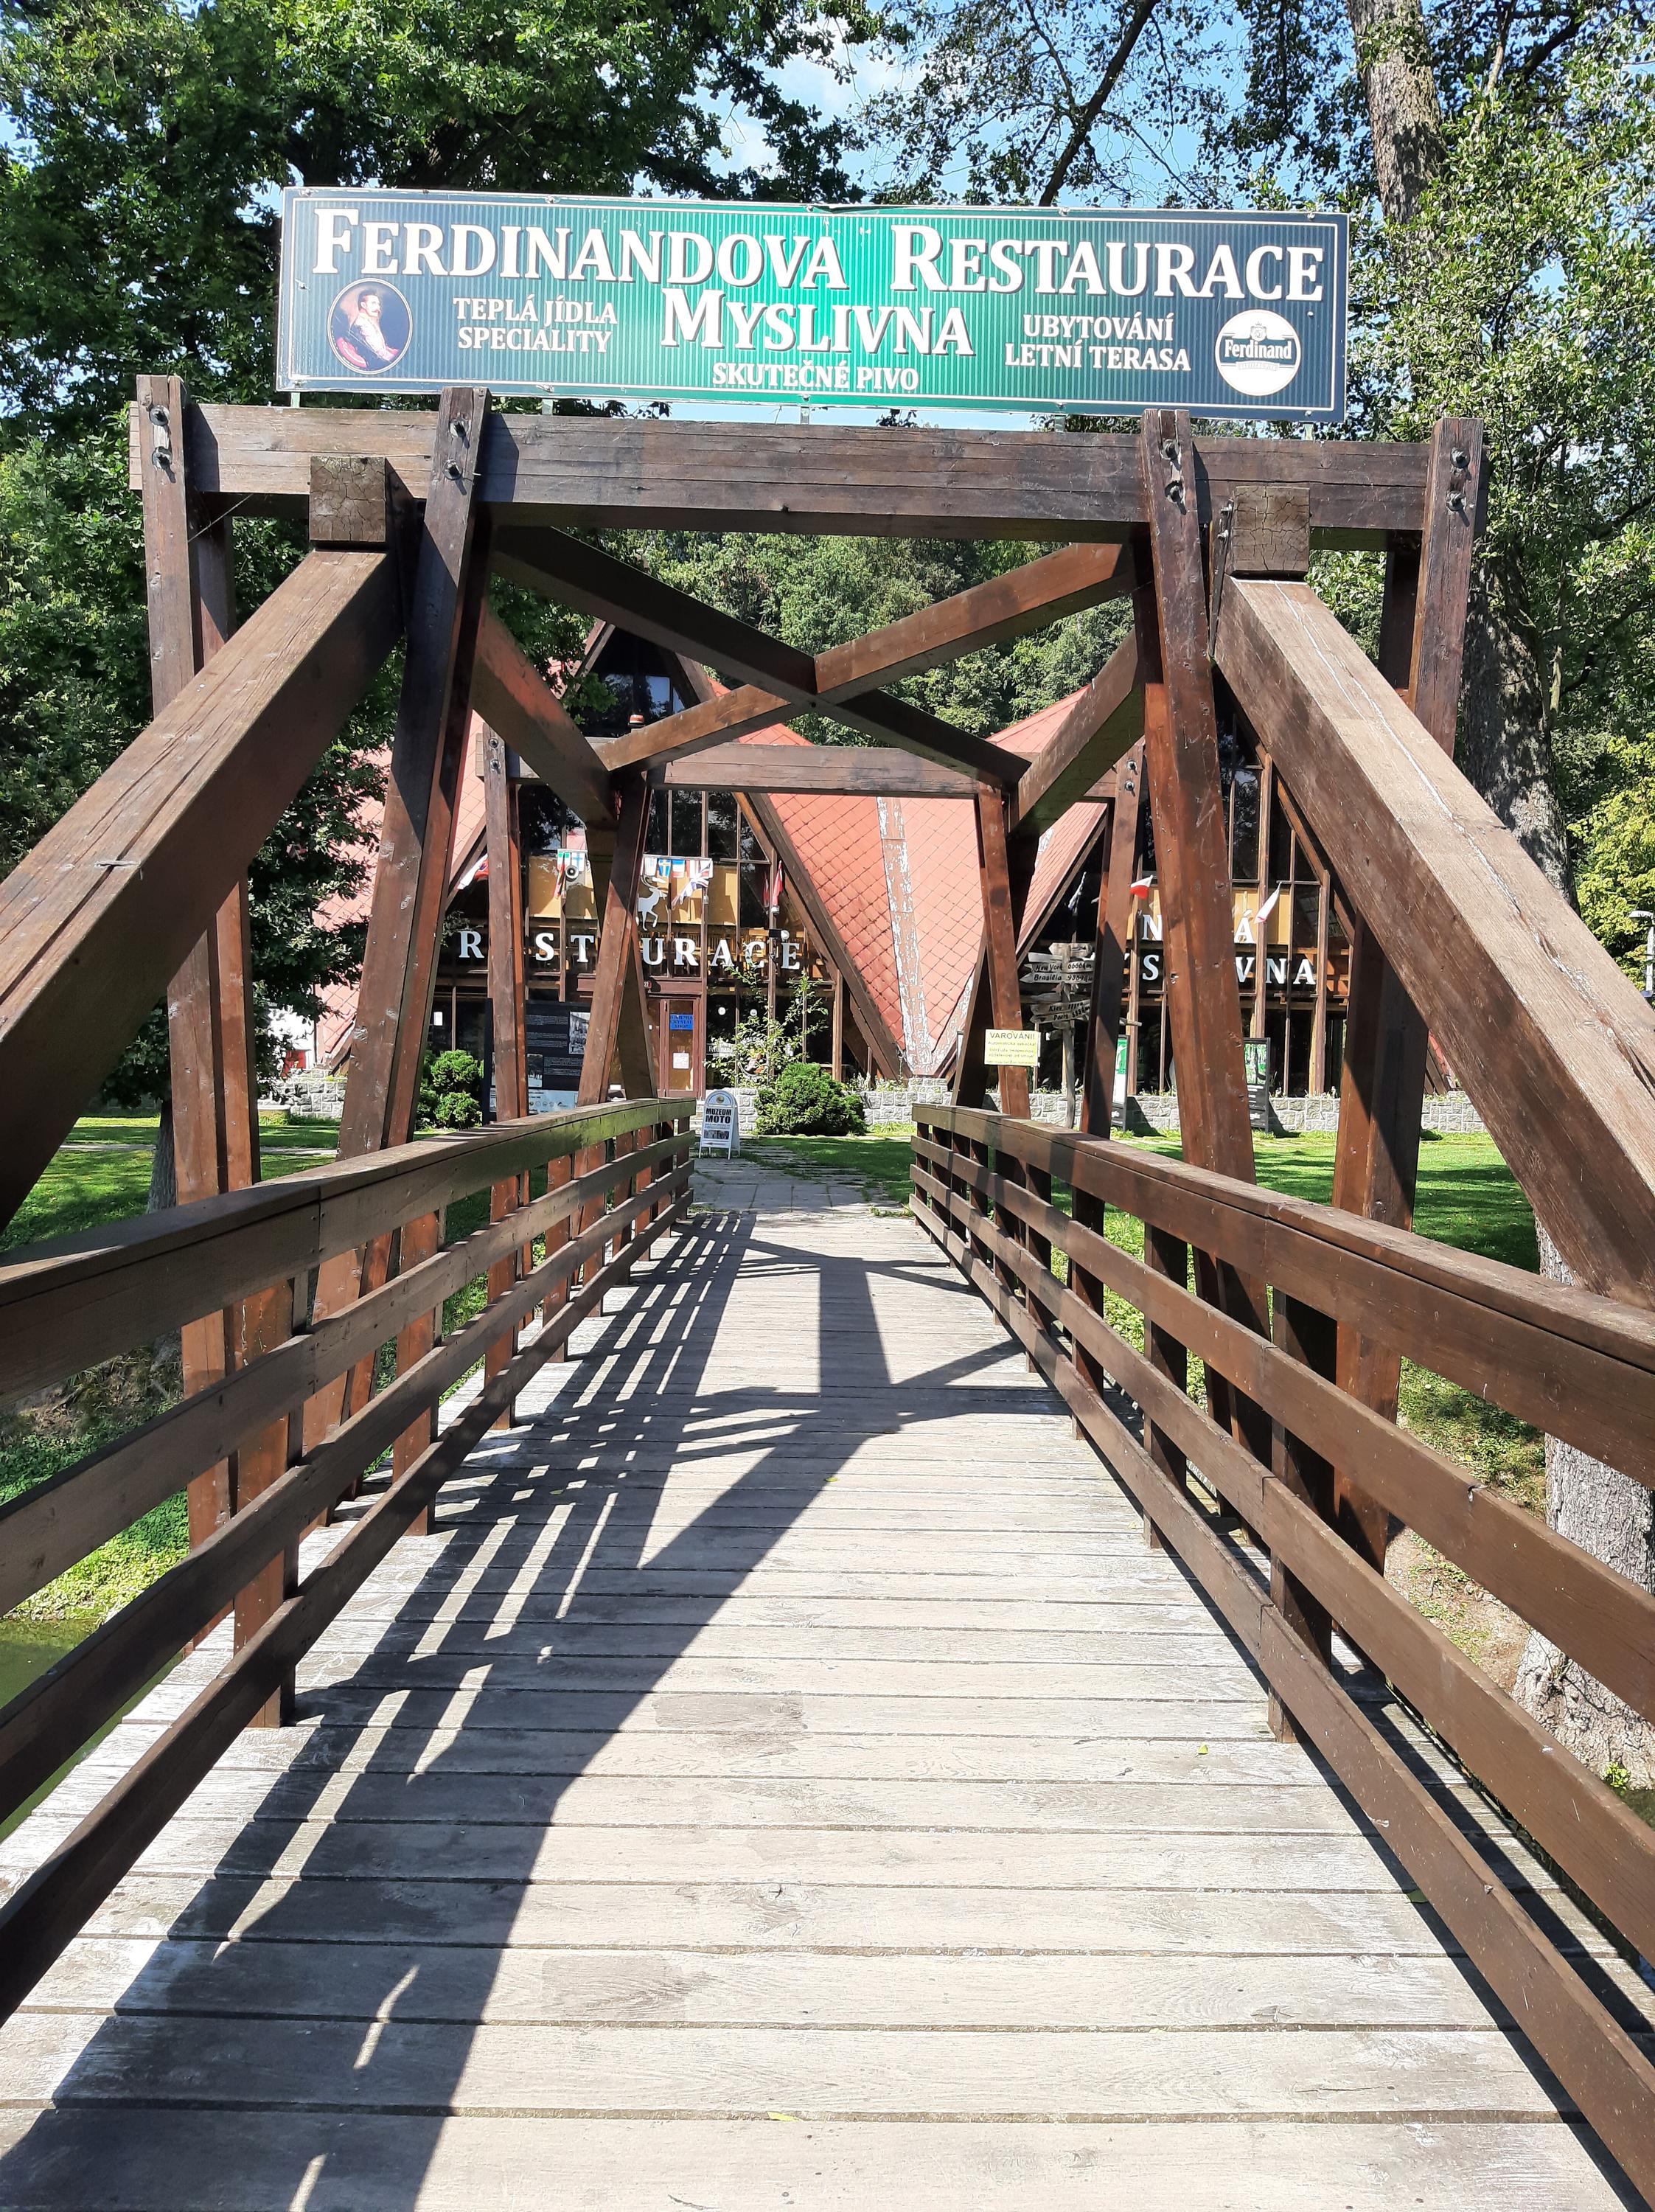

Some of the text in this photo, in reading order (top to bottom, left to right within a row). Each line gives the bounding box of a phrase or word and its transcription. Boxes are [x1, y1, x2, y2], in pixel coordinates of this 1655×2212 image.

[312, 207, 1323, 302] FERDINANDOVA RESTAURACE
[453, 293, 618, 326] TEPLÁ JÍDLA
[661, 287, 976, 358] MYSLIVNA
[458, 327, 613, 354] SPECIALITY
[1023, 311, 1174, 342] UBYTOVÁNÍ
[1005, 339, 1191, 372] LETNÍ TERASA
[1224, 339, 1292, 360] Ferdinand
[713, 359, 919, 392] SKUTEČNÉ PIVO
[1143, 910, 1255, 944] NÁ
[459, 930, 801, 970] RSTURACE
[705, 1115, 731, 1124] MOTO
